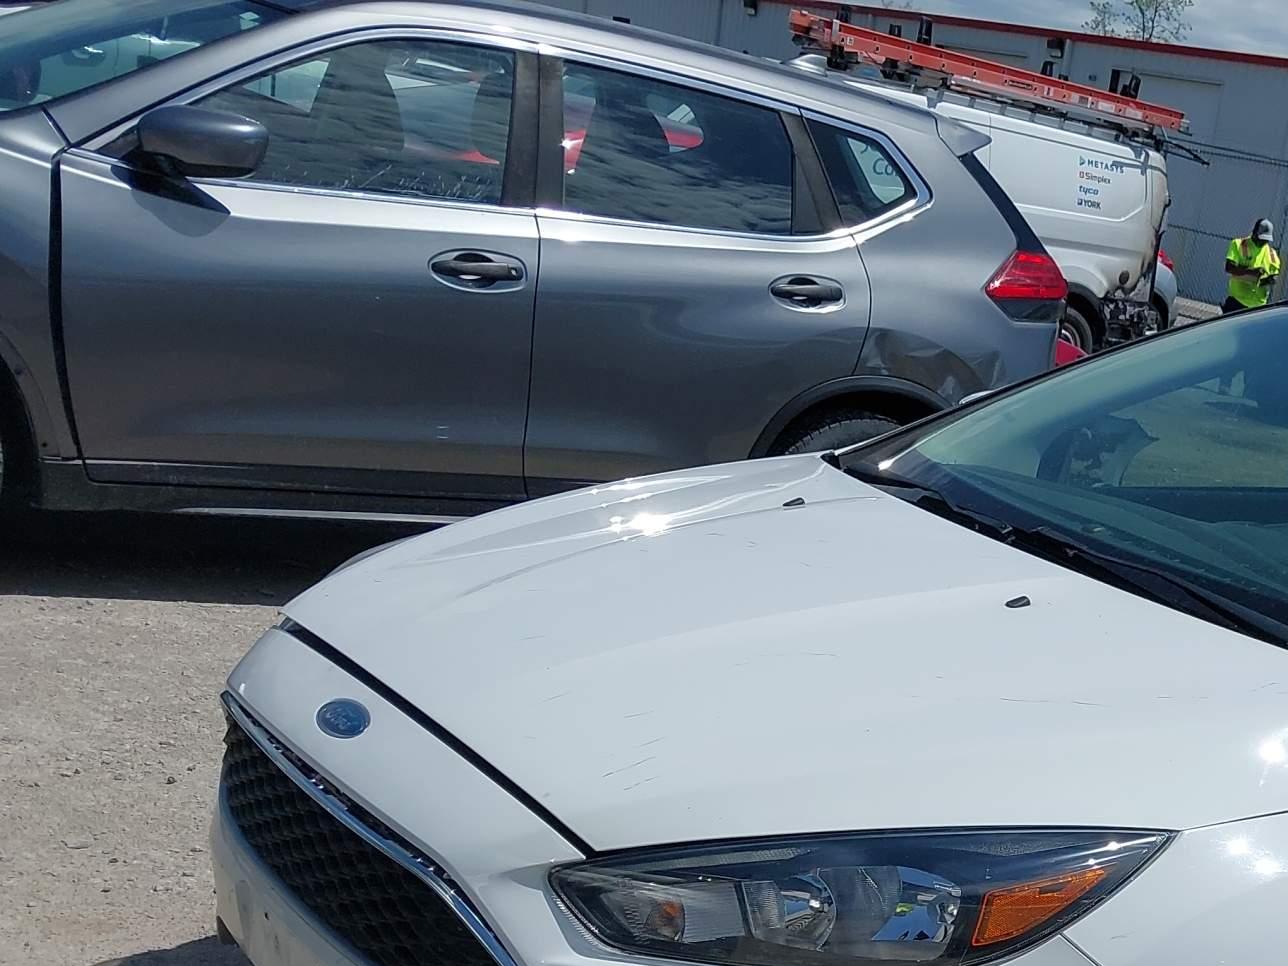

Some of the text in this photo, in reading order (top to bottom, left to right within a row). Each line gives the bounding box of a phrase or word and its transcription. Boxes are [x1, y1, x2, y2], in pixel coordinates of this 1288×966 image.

[1087, 159, 1124, 174] METASYS
[1085, 171, 1111, 184] Simplex
[1079, 185, 1099, 195] tyco
[1083, 198, 1101, 210] YORK
